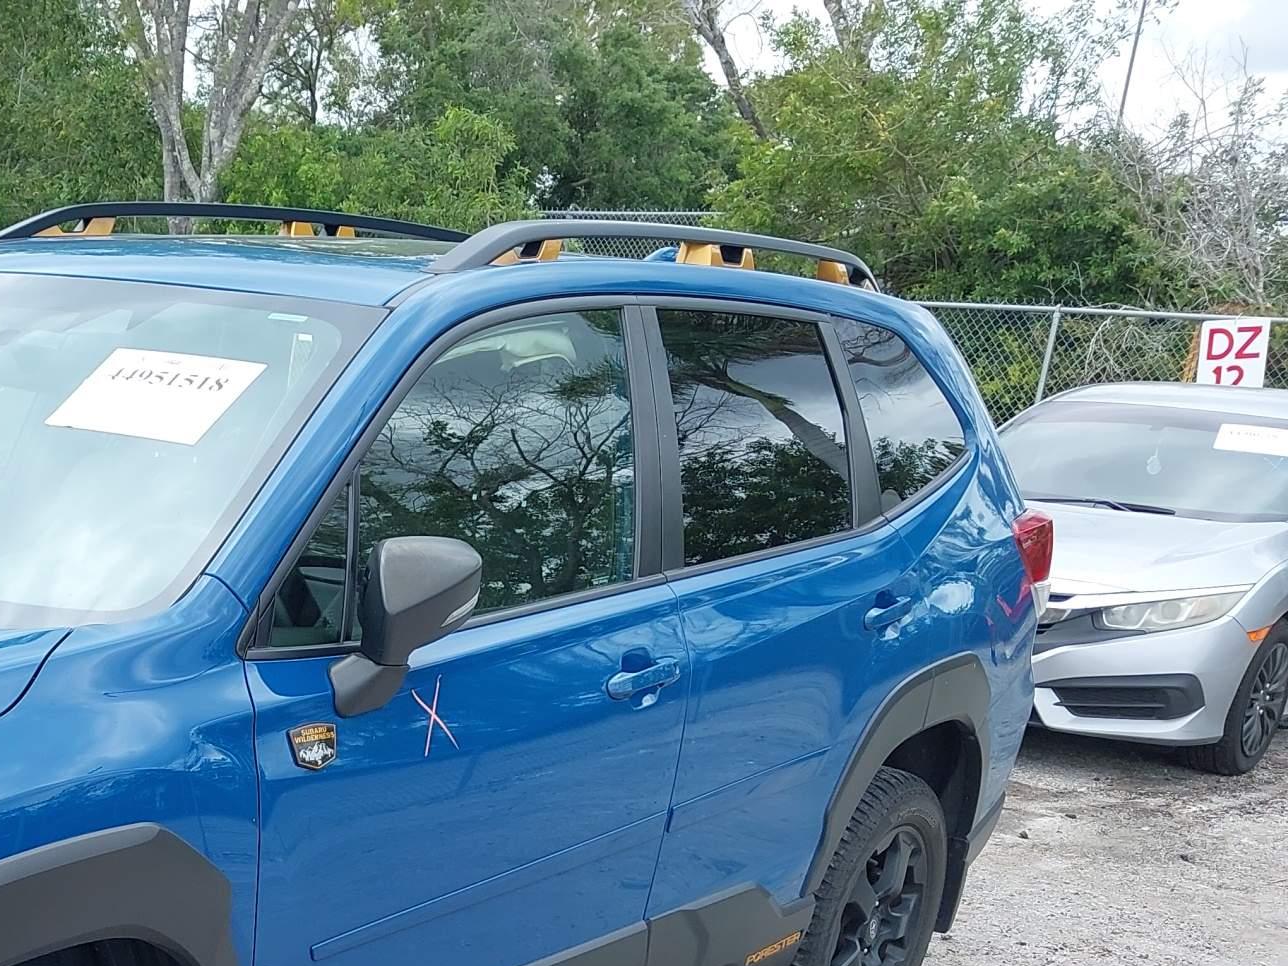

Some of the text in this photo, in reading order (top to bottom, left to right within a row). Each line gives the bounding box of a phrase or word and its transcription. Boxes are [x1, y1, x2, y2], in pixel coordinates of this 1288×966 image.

[1206, 325, 1263, 360] DZ
[301, 726, 327, 736] SUBARU
[745, 931, 802, 966] FORESTER
